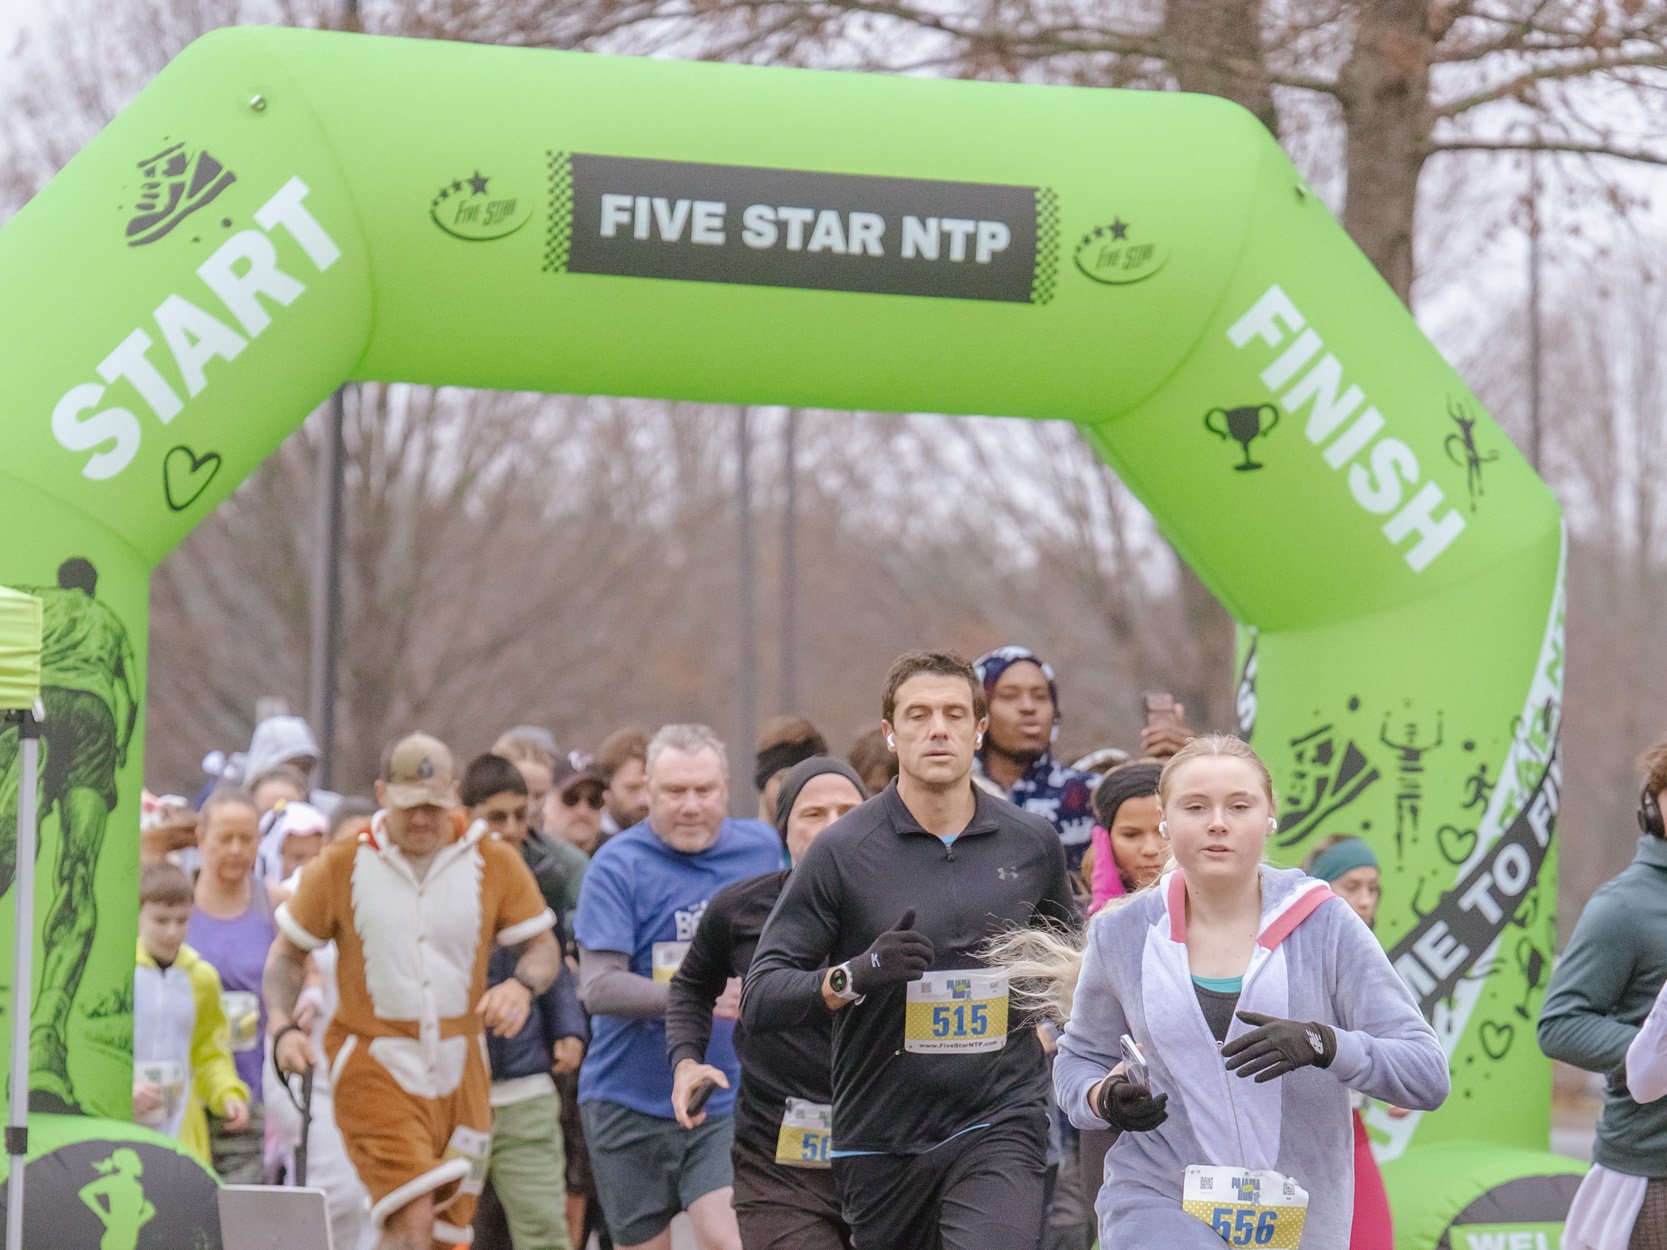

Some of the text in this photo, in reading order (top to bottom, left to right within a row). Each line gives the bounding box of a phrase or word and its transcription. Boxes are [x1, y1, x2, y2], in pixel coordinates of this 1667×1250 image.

[599, 192, 1012, 265] FIVE STAR NTP
[51, 175, 341, 481] START
[1226, 283, 1467, 574] FINISH
[1457, 842, 1532, 925] TO
[932, 1004, 988, 1037] 515
[1211, 1207, 1278, 1246] 556
